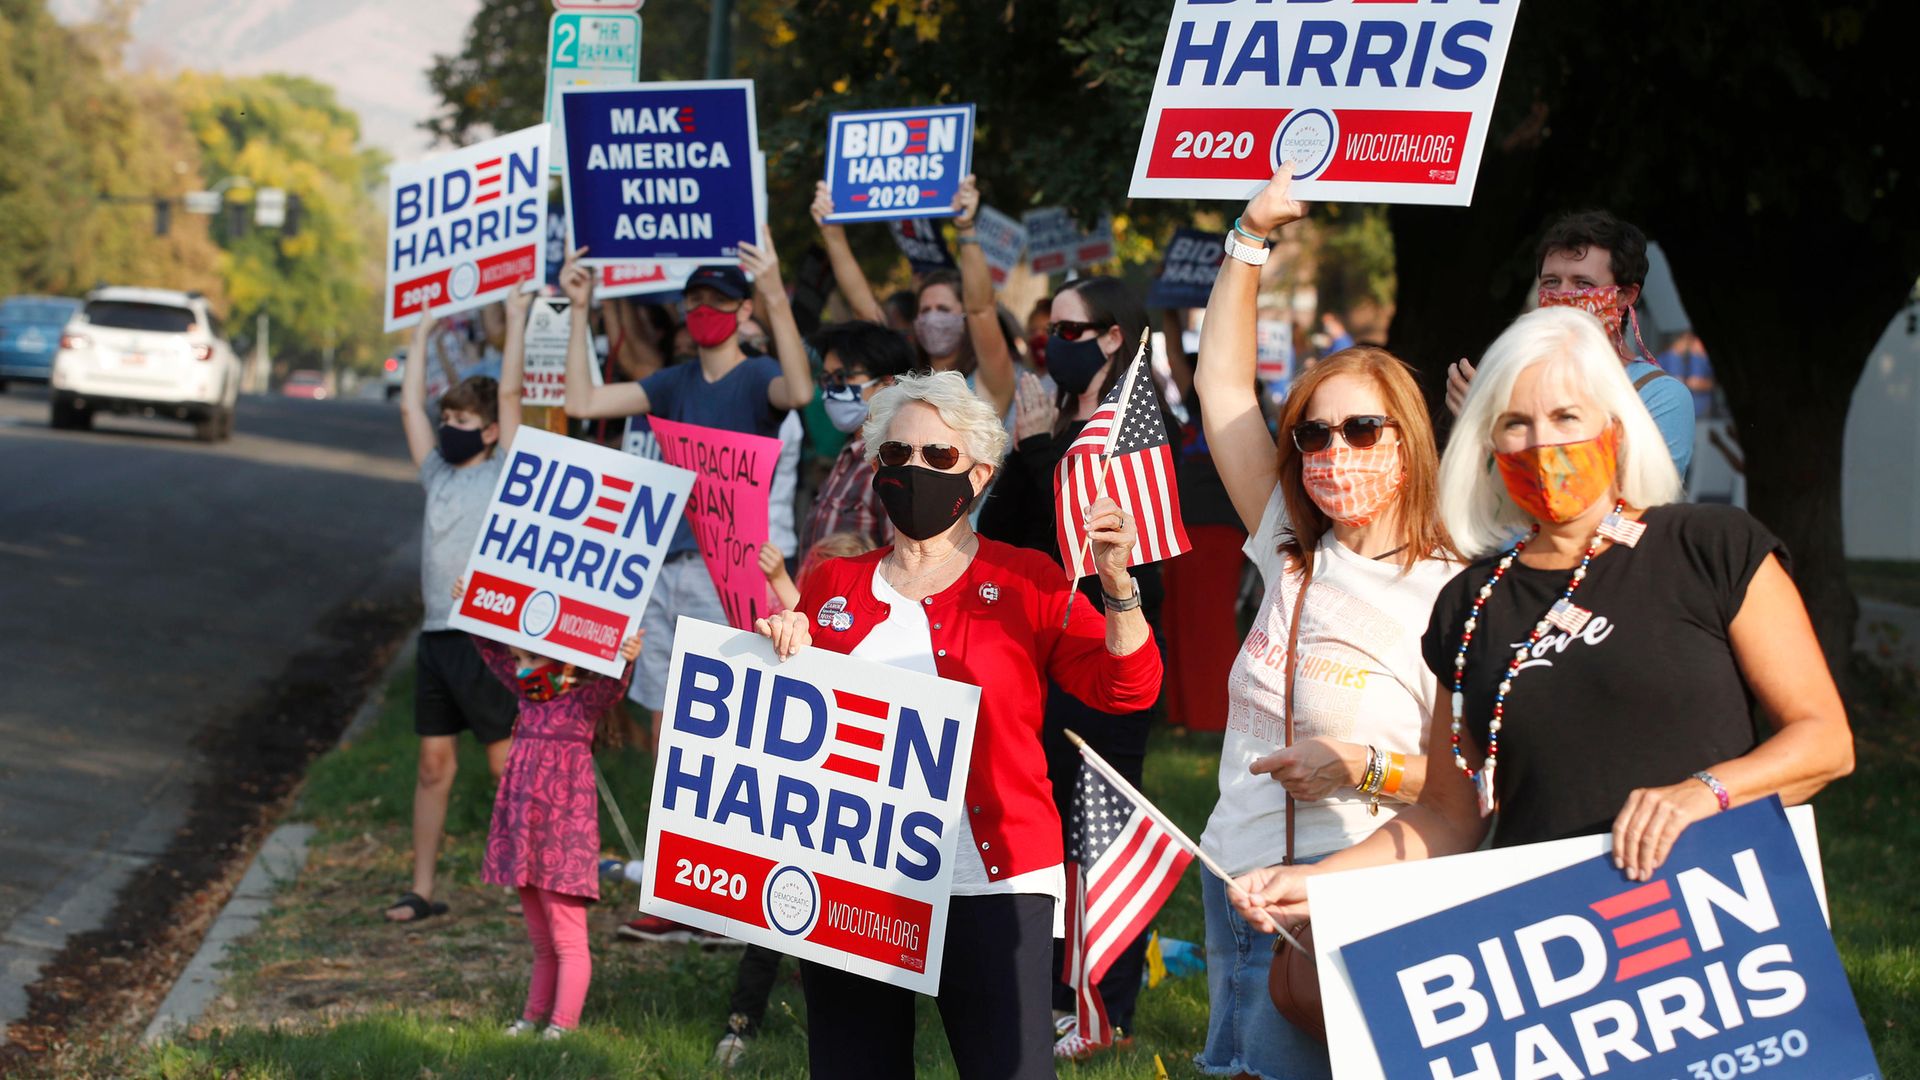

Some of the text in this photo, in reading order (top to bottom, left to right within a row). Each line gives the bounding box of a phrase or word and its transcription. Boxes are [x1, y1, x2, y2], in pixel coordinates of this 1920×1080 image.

[556, 22, 621, 62] 2 HR
[581, 44, 633, 63] PARKING
[1166, 19, 1494, 91] HARRIS
[610, 107, 696, 135] MAKE
[841, 116, 958, 159] BIDEN
[587, 142, 731, 170] AMERICA
[1172, 130, 1455, 164] 2020 WDCUTAH.ORG
[395, 146, 540, 229] BIDEN
[847, 153, 944, 185] HARRIS
[622, 178, 700, 205] KIND
[867, 184, 920, 209] 2020
[394, 198, 539, 272] HARRIS
[614, 213, 713, 240] AGAIN
[402, 282, 441, 308] 2020
[499, 451, 676, 547] BIDEN
[479, 514, 651, 600] HARRIS
[472, 587, 516, 615] 2020
[558, 612, 620, 648] WDCUTAH.ORG
[1300, 654, 1370, 690] HIPPIES
[673, 651, 960, 802] BIDEN
[662, 745, 944, 881] HARRIS
[674, 858, 921, 951] 2020 WDCUTAH.ORG
[774, 891, 809, 907] DEMOCRATIC
[1397, 848, 1780, 1049] BIDEN
[1429, 943, 1807, 1080] HARRIS
[1687, 1029, 1809, 1080] 30330
